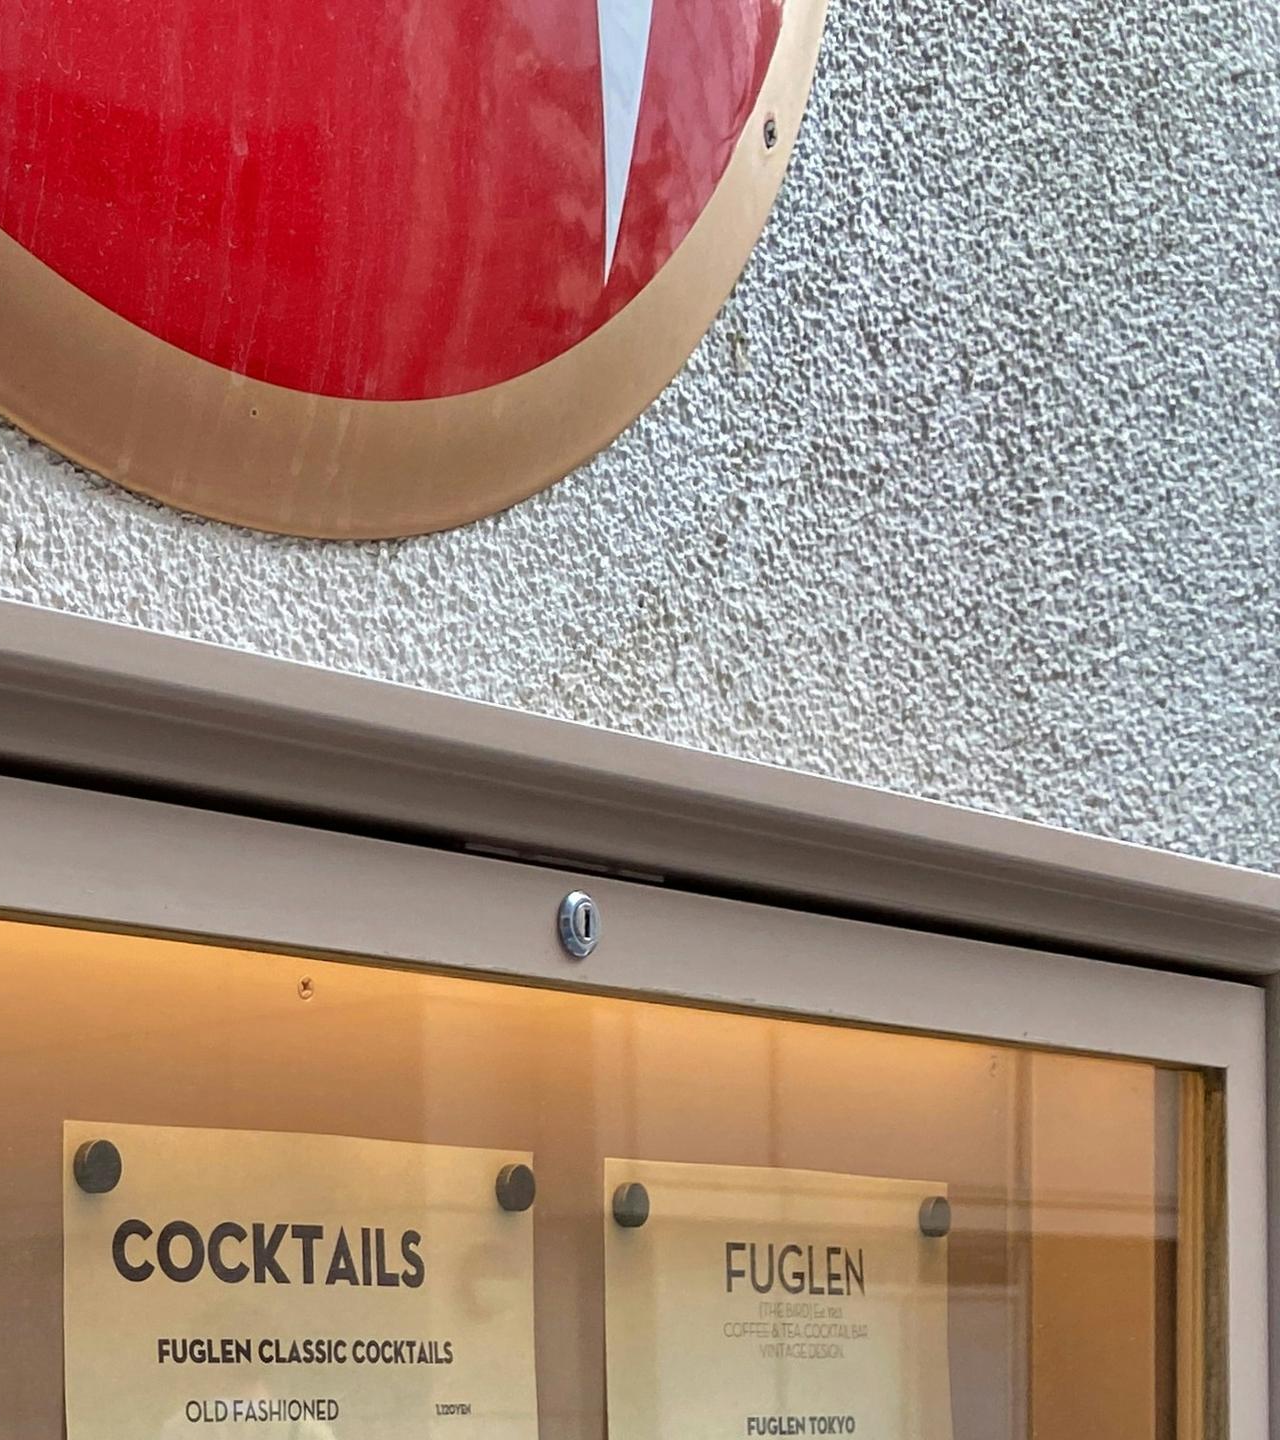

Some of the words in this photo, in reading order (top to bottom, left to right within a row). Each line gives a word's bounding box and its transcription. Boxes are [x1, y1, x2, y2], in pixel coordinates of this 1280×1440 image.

[112, 1218, 425, 1288] COCKTAILS
[726, 1242, 865, 1296] FUGLEN
[157, 1339, 251, 1364] FUGLEN
[258, 1339, 347, 1364] CLASSIC
[352, 1341, 454, 1364] COCKTAILS
[185, 1401, 228, 1423] OLD
[233, 1399, 339, 1423] FASHIONED
[747, 1416, 806, 1436] FUGLEN
[809, 1416, 855, 1434] TOKYO
